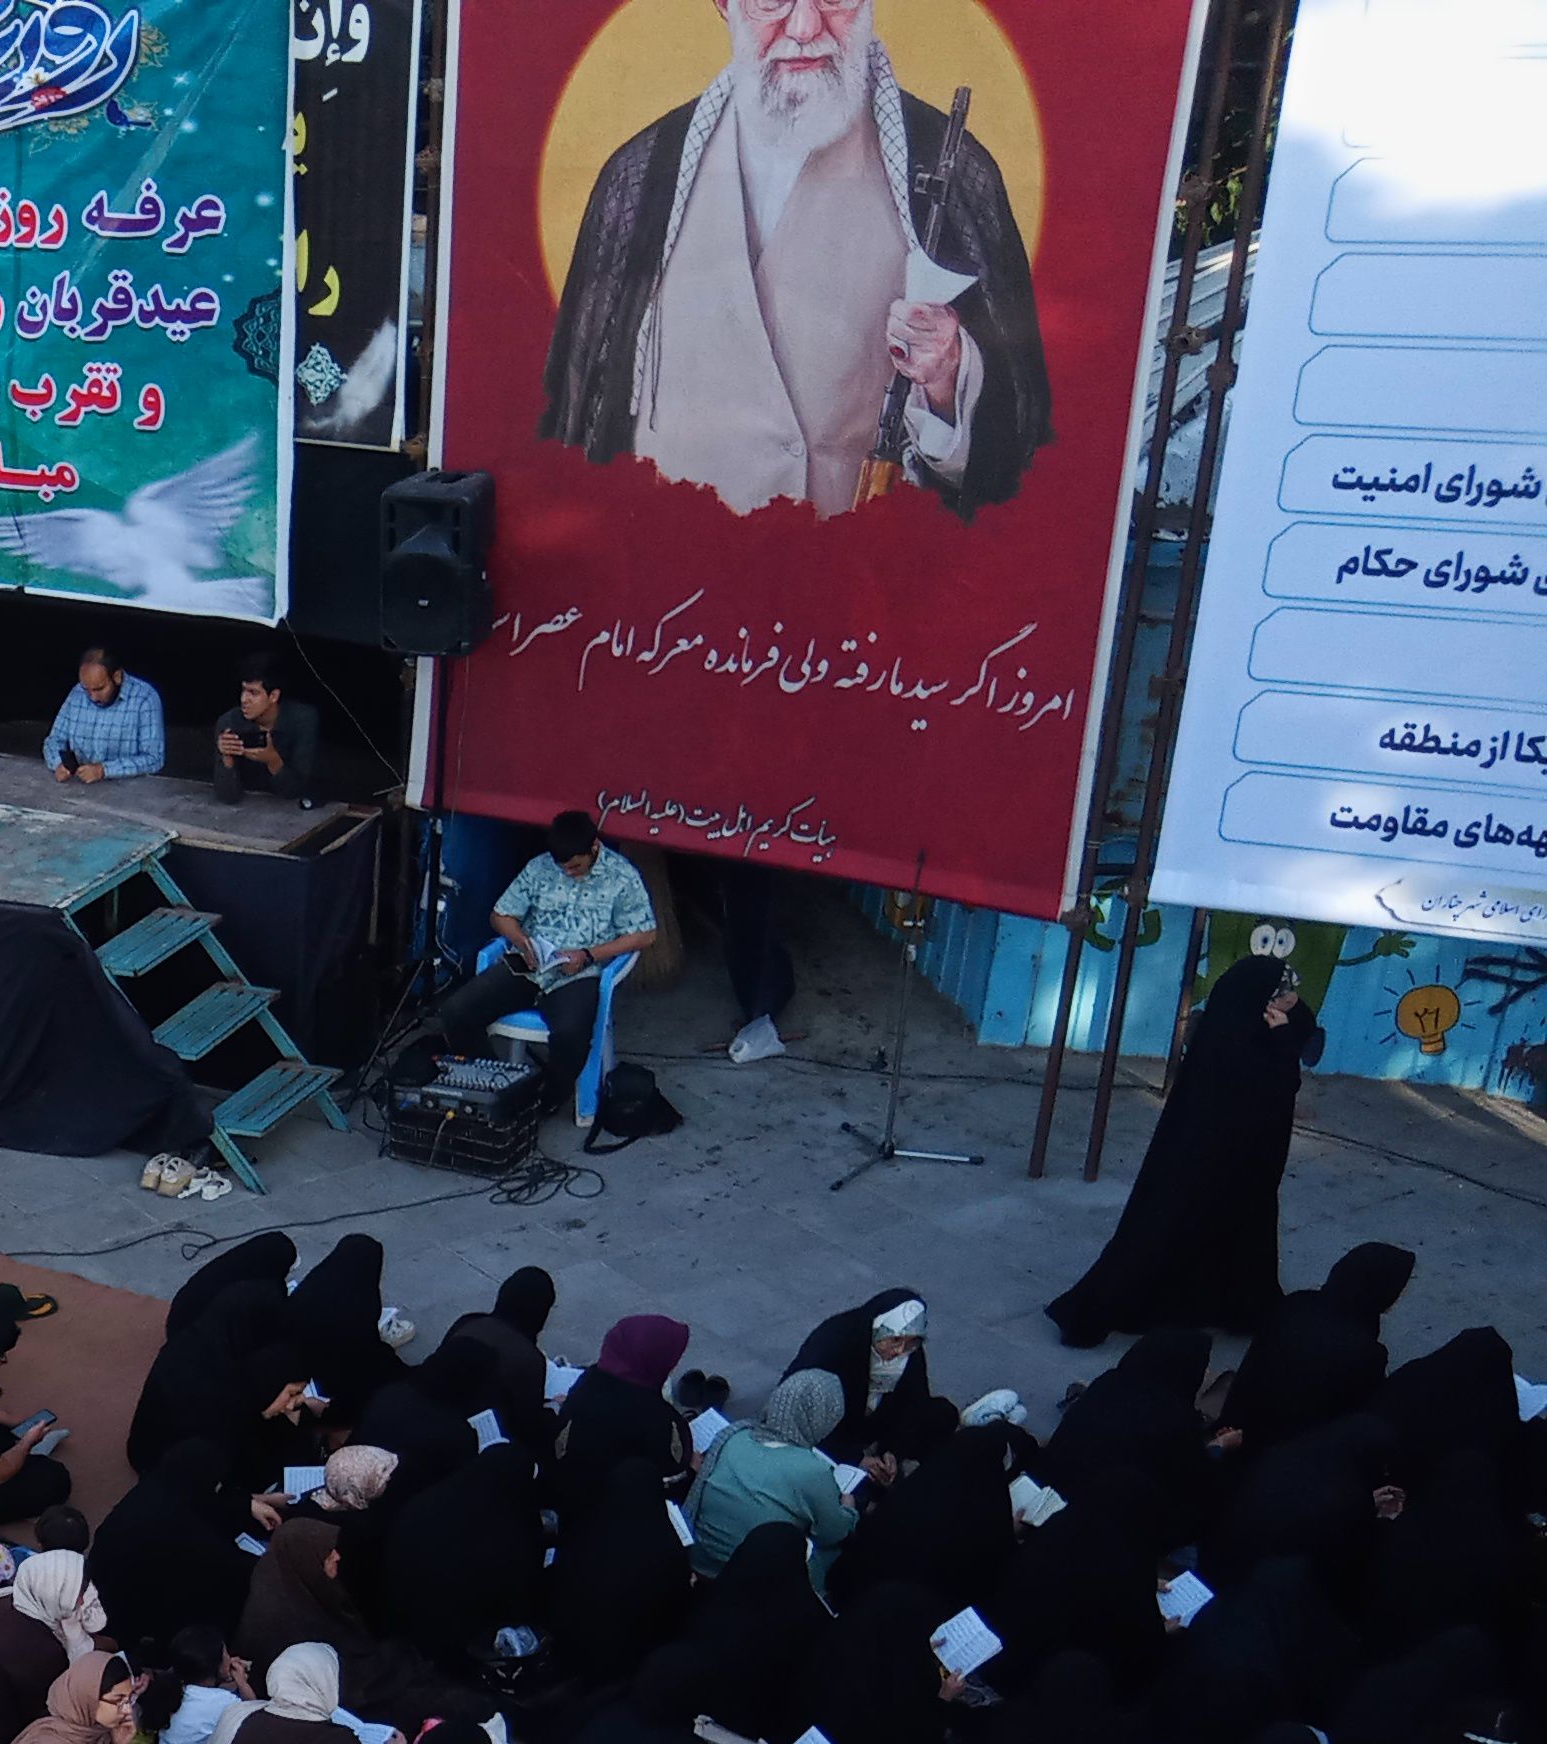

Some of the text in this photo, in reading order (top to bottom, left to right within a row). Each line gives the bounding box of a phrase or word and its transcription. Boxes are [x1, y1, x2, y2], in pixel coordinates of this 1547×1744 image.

[10, 362, 123, 426] تقرب
[133, 382, 165, 430] و
[1332, 462, 1541, 507] شورای امنیت
[1337, 546, 1418, 583] حکام
[1423, 551, 1529, 593] شورای
[509, 607, 583, 657] عصر
[578, 619, 634, 692] امام
[636, 588, 704, 675] معرکه
[704, 621, 784, 687] فرمانده
[779, 638, 829, 693] ولی
[834, 632, 886, 691] رفته
[951, 622, 1037, 707] اگر
[901, 679, 949, 730] سید
[997, 668, 1074, 731] امروز
[1379, 722, 1481, 758] منطقه
[1479, 730, 1510, 769] از
[722, 804, 752, 837] اهل
[744, 797, 815, 857] کریم
[1330, 803, 1448, 842] مقاومت
